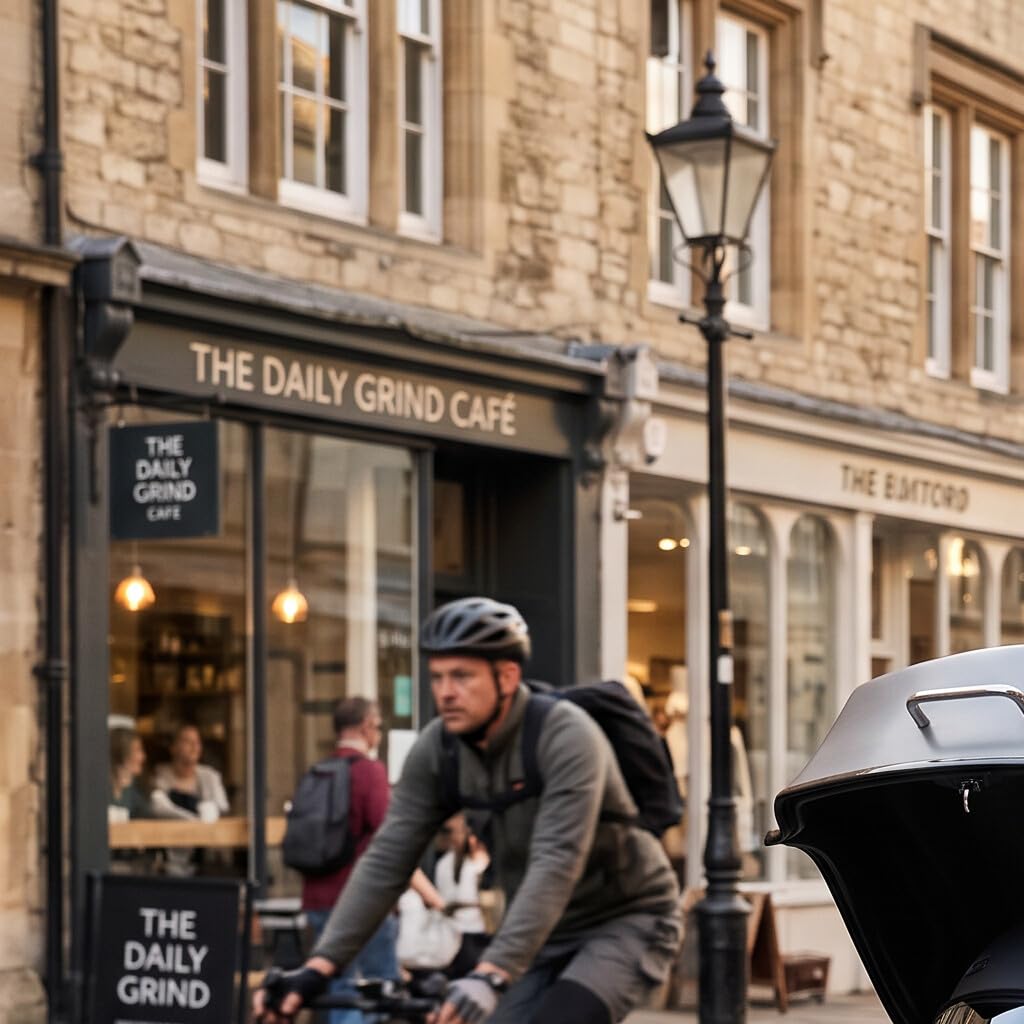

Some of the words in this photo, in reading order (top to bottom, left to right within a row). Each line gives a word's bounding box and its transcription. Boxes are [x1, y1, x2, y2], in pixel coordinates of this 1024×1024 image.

[188, 341, 255, 392] THE
[262, 355, 349, 407] DAILY
[353, 372, 446, 424] GRIND
[450, 392, 517, 437] CAFÉ
[144, 434, 184, 457] THE
[135, 456, 193, 480] DAILY
[841, 464, 877, 497] THE
[133, 480, 197, 504] GRIND
[139, 907, 197, 940] THE
[124, 940, 209, 974] DAILY
[116, 974, 211, 1010] GRIND
